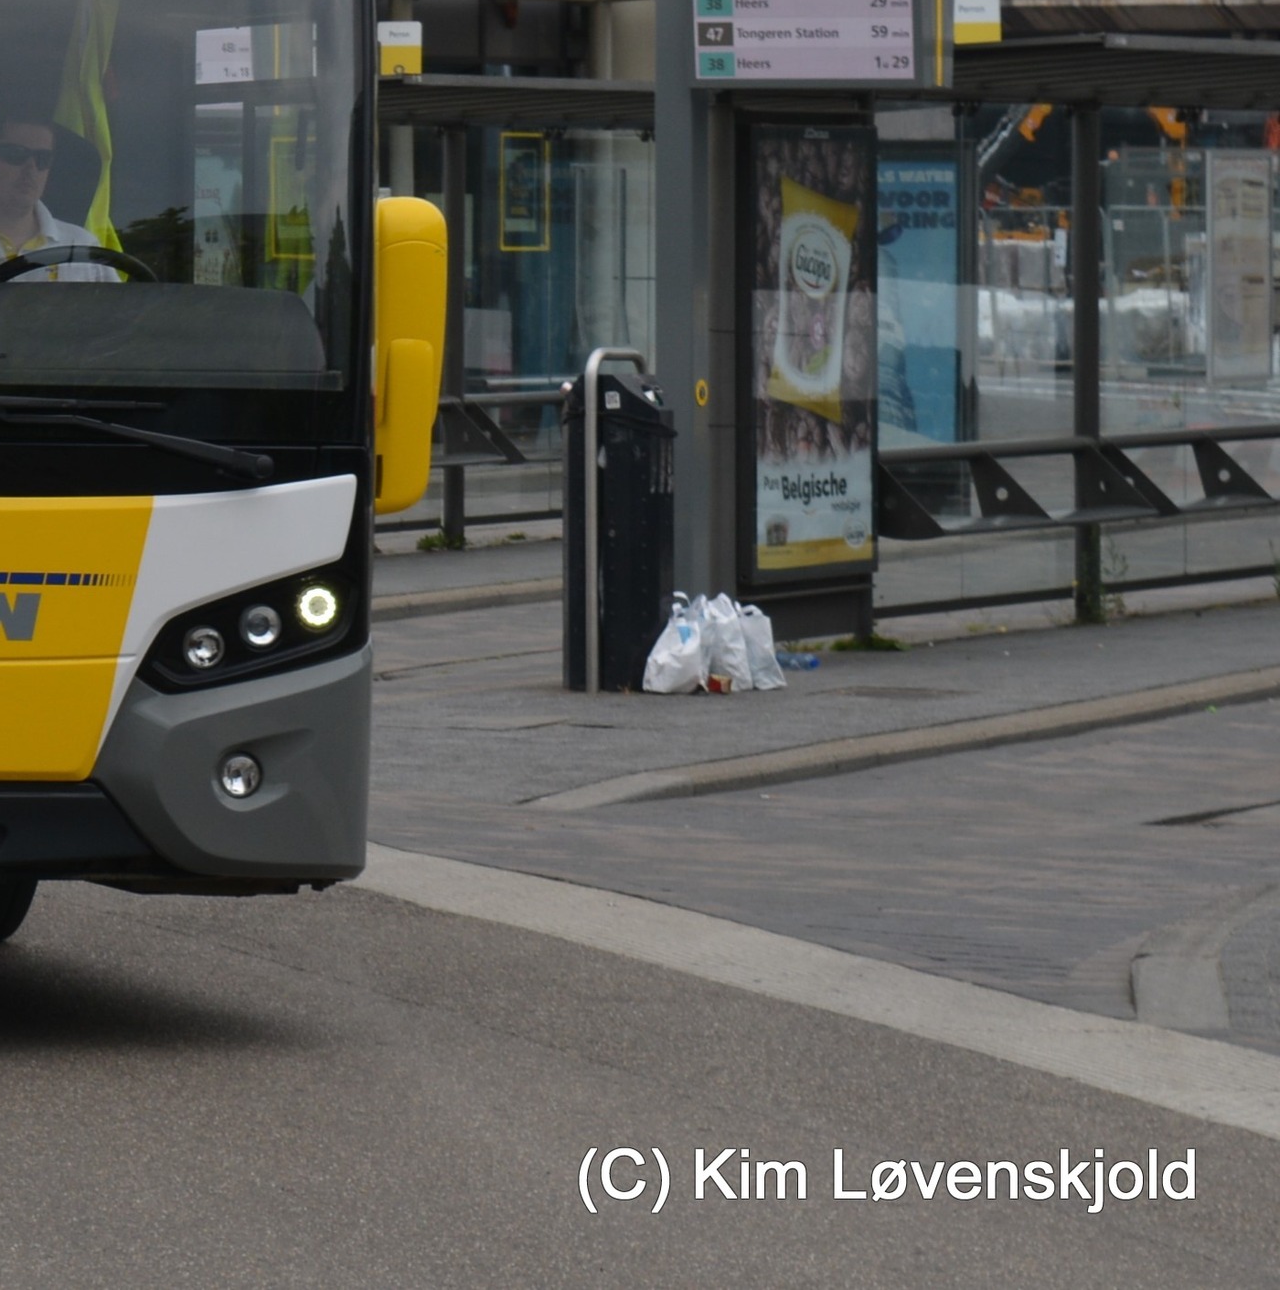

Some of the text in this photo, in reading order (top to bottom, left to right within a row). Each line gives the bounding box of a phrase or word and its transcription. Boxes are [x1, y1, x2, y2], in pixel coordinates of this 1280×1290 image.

[705, 28, 724, 41] 47
[737, 28, 792, 40] Tongeren
[795, 27, 839, 38] Station
[871, 25, 888, 38] 59
[707, 58, 725, 70] 38
[737, 58, 771, 69] Heers
[892, 56, 910, 69] 29
[782, 471, 847, 506] Belgische
